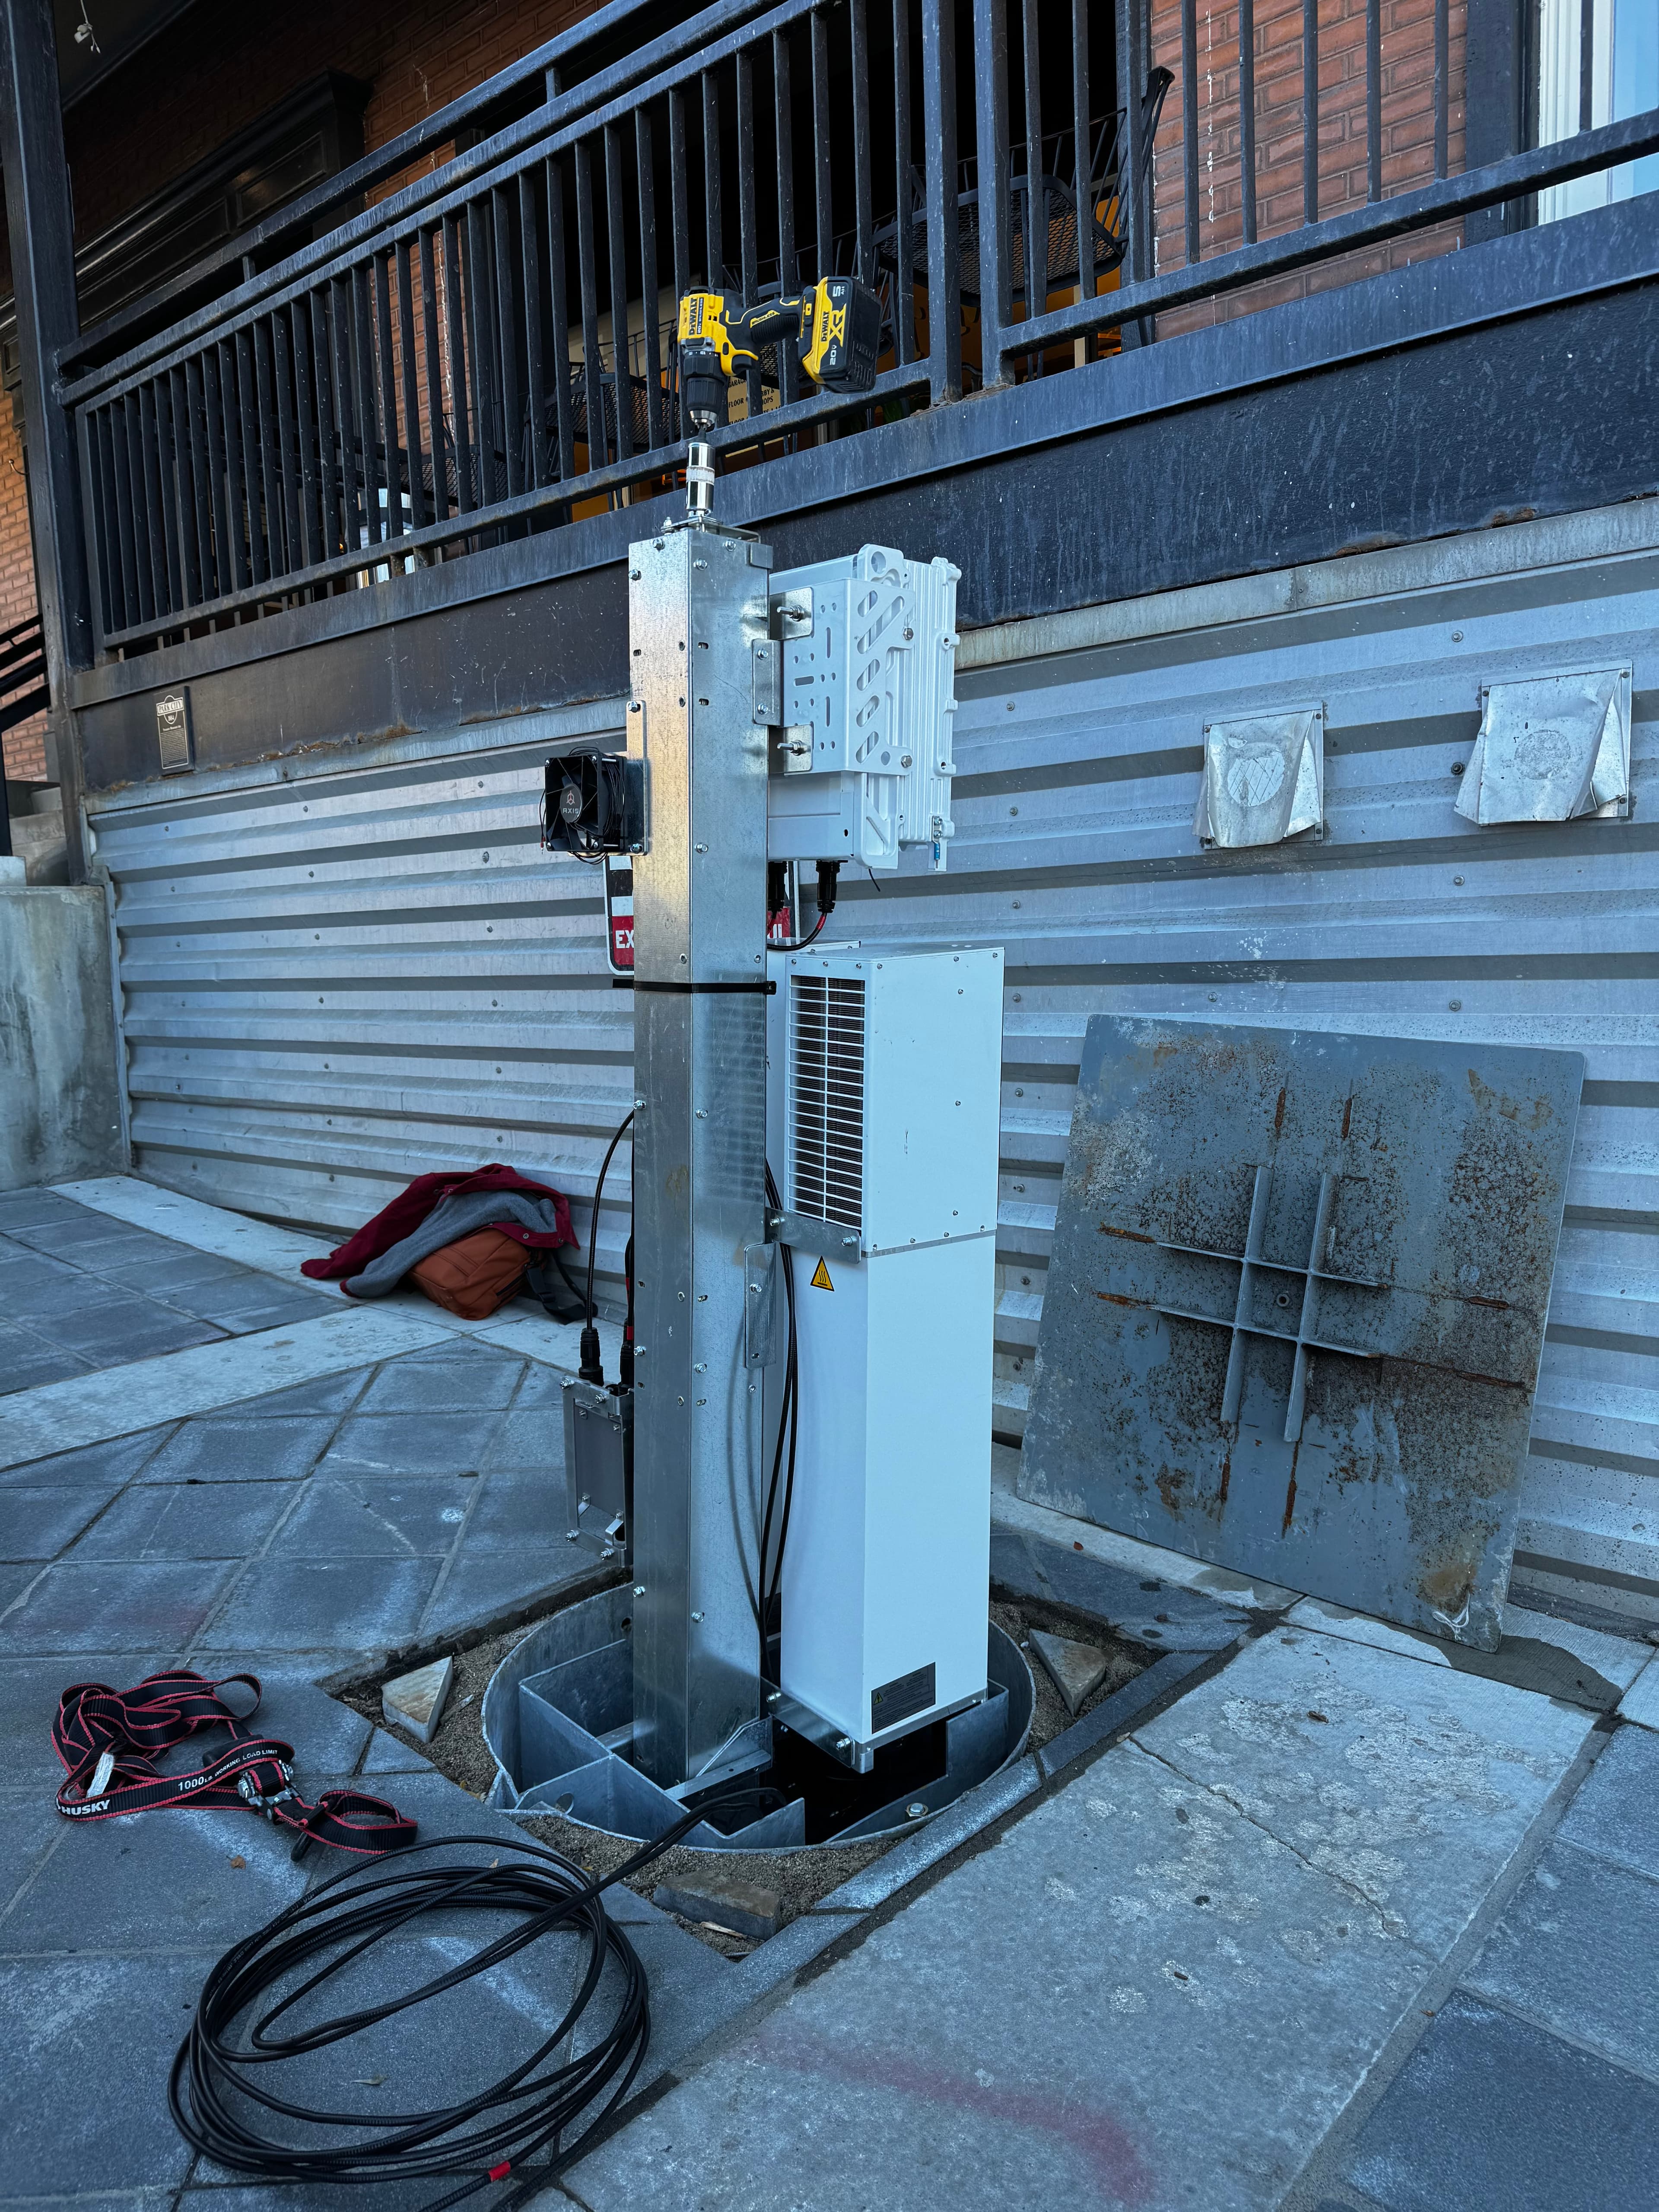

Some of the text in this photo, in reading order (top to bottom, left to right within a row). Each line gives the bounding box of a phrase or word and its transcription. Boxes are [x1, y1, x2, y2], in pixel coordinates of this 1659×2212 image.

[833, 286, 841, 297] 5
[689, 297, 698, 336] DEWALT
[821, 311, 830, 342] DEWALT
[829, 303, 847, 347] XR
[728, 397, 744, 408] FLOOR
[159, 701, 181, 713] PARK CITY
[178, 1776, 204, 1791] 1000
[215, 1758, 241, 1777] WORKING
[242, 1751, 261, 1761] LOAD
[61, 1799, 110, 1815] HUSKY
